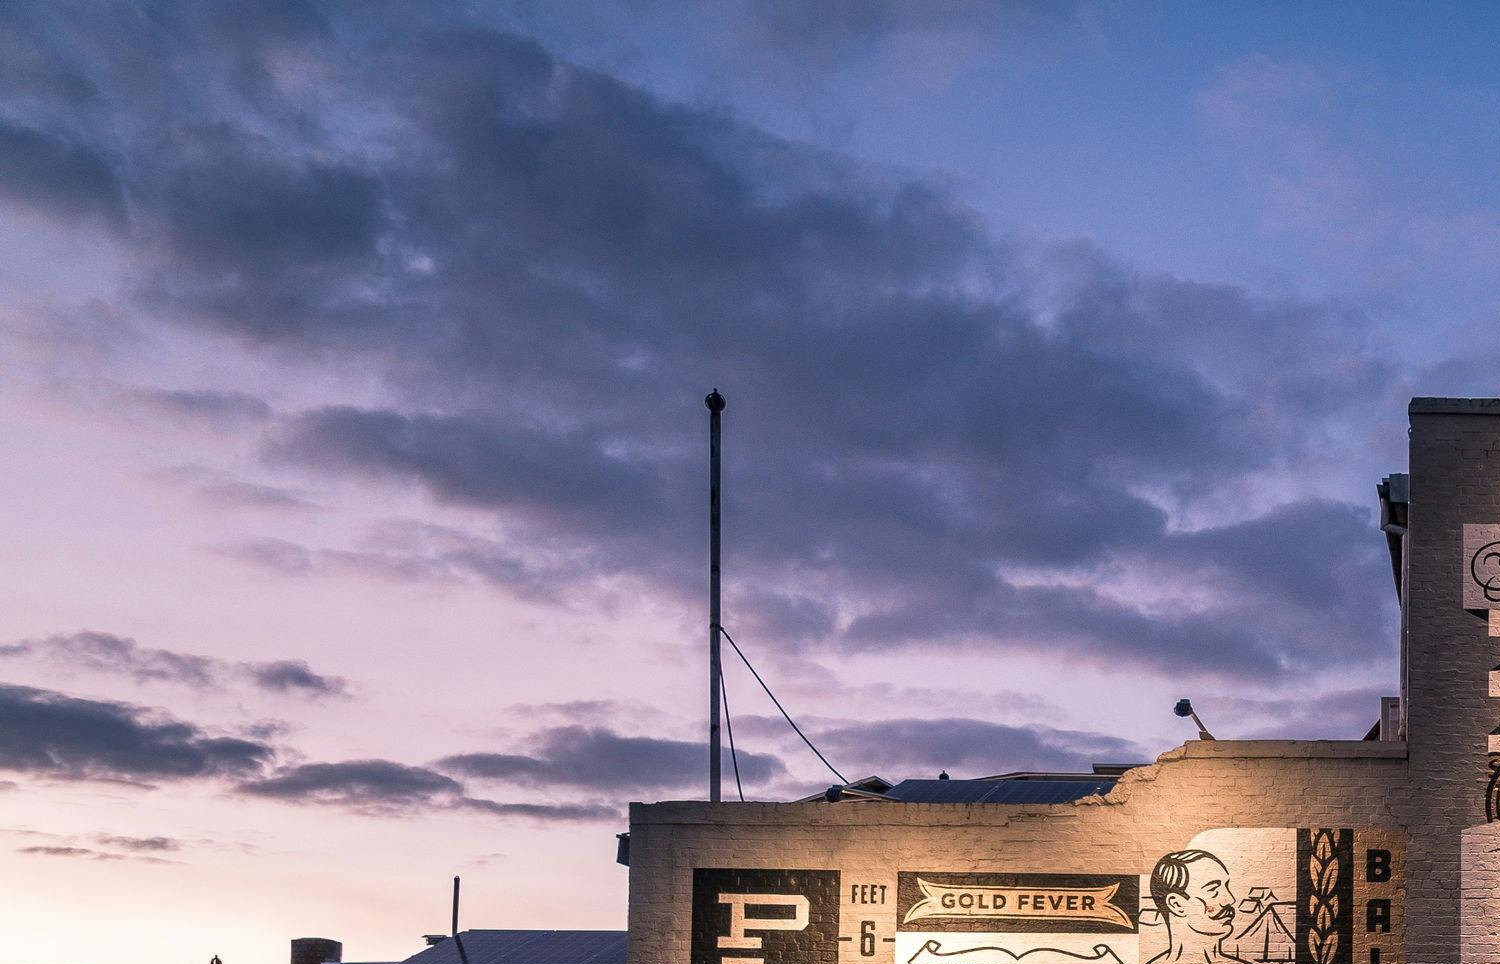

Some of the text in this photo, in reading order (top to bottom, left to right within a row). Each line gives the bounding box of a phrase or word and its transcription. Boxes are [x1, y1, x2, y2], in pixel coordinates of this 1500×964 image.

[851, 885, 887, 904] FEET
[941, 893, 1095, 911] GOLD FEVER
[860, 921, 876, 957] 6
